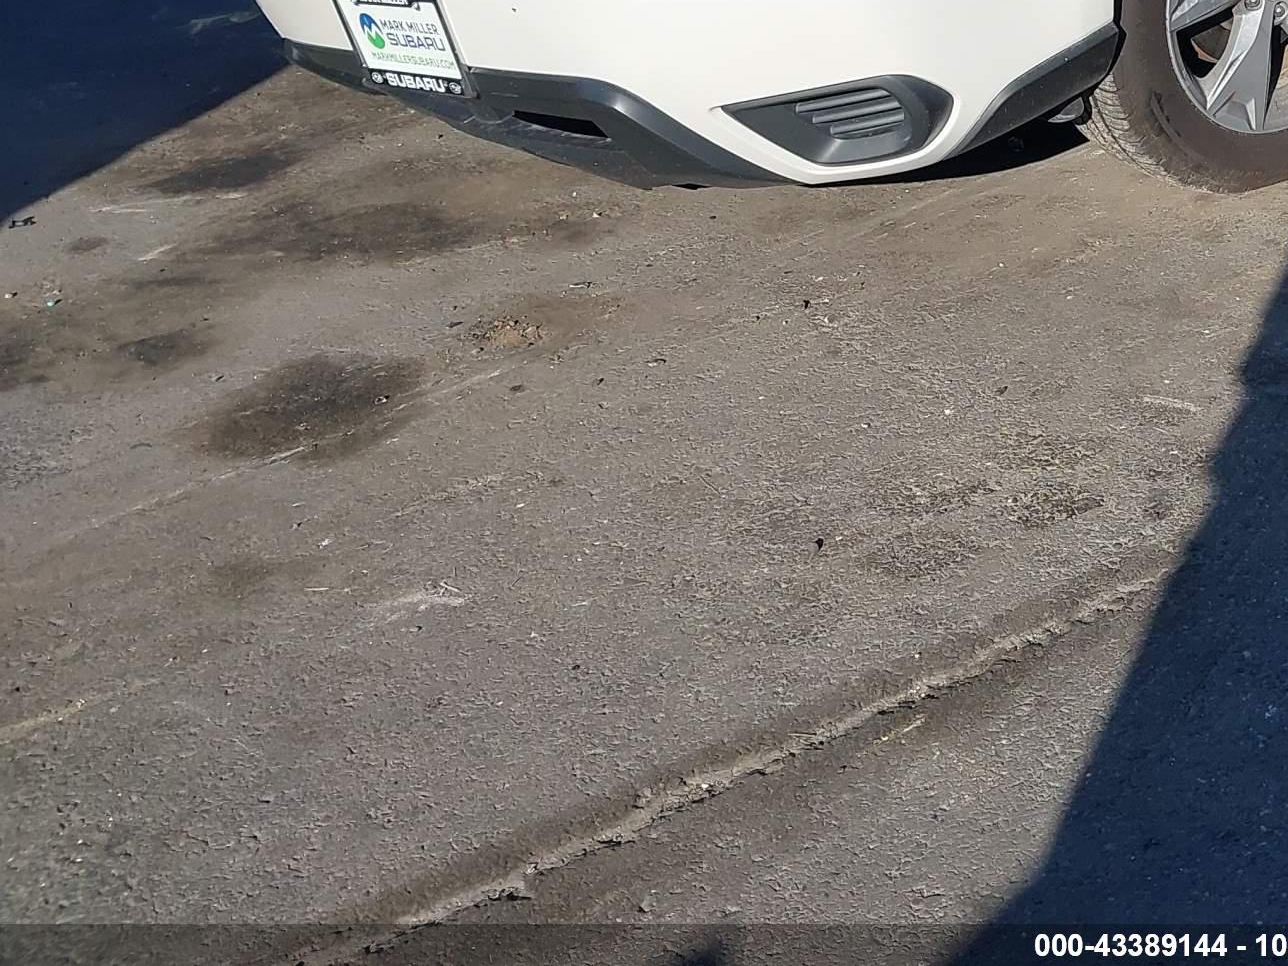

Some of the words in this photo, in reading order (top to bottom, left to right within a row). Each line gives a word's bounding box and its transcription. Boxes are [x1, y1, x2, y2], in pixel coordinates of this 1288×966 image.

[380, 18, 404, 32] MARK
[405, 22, 439, 35] MILLER
[386, 32, 446, 52] SUBARU
[386, 72, 446, 93] SUBARU
